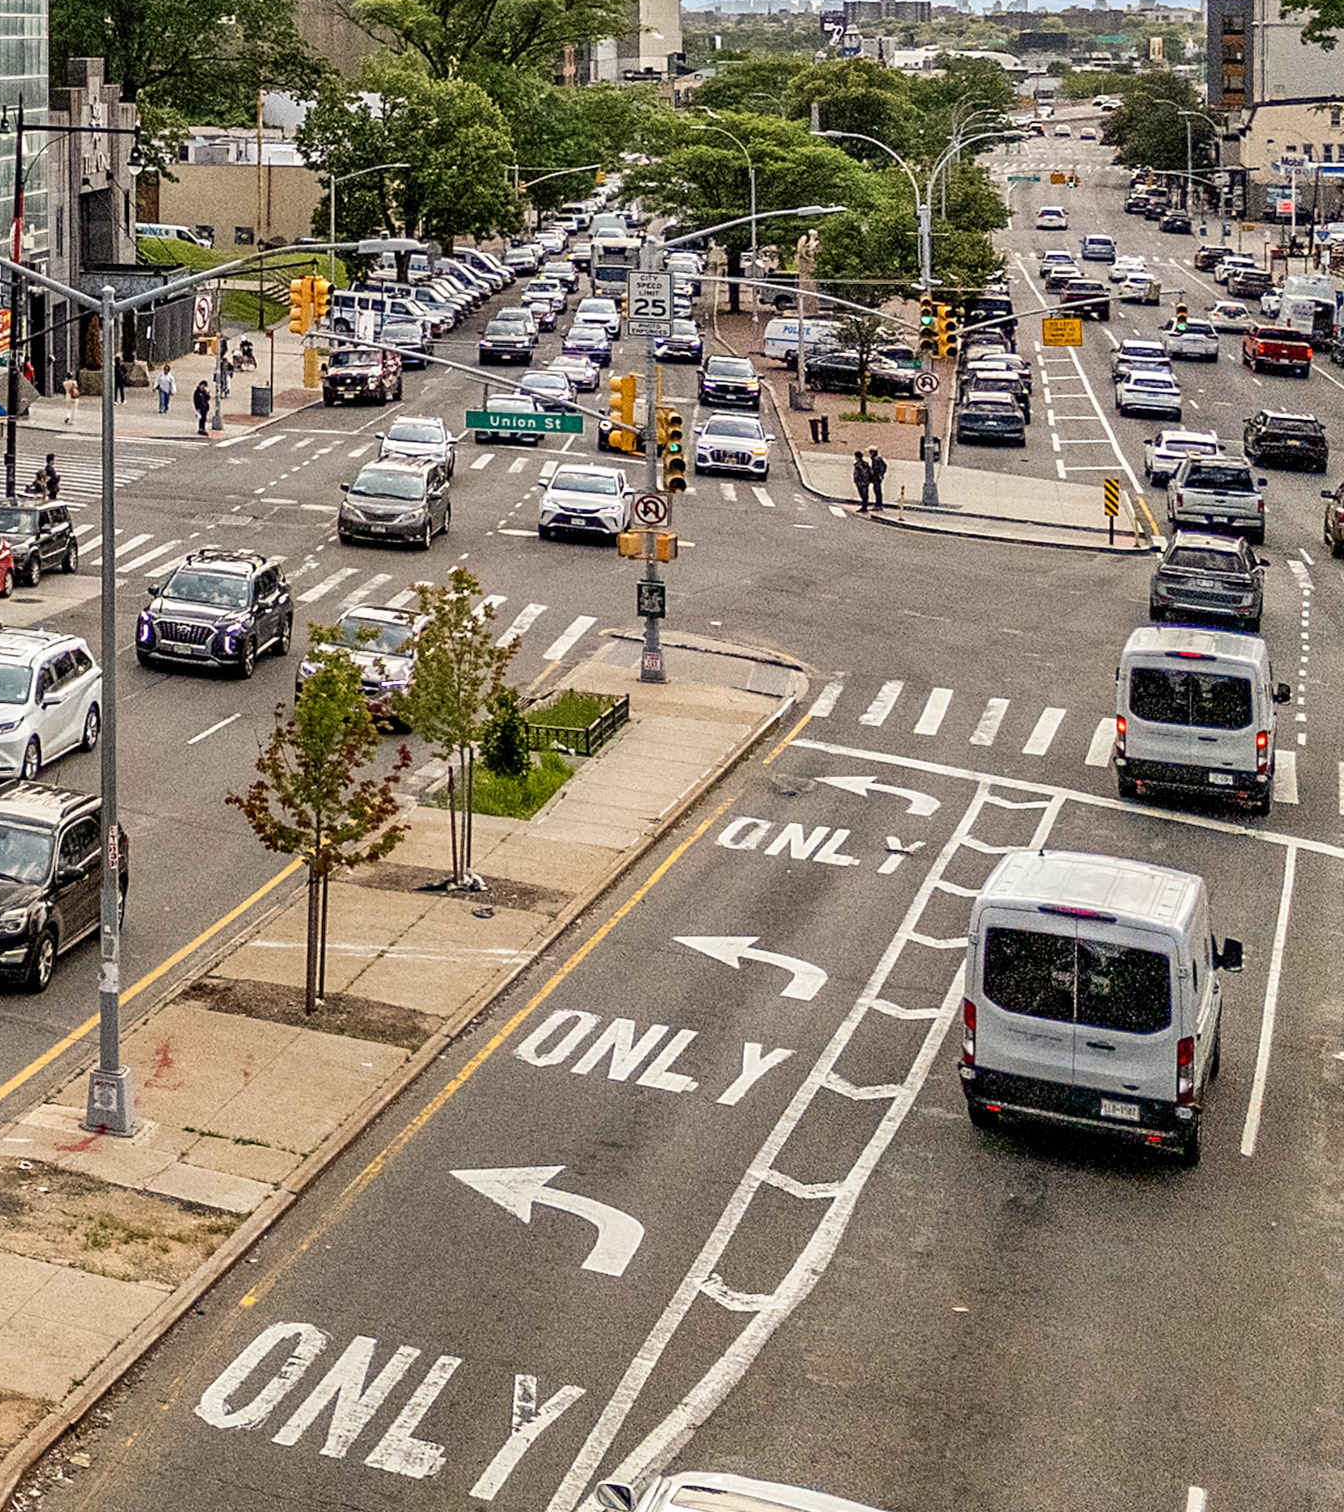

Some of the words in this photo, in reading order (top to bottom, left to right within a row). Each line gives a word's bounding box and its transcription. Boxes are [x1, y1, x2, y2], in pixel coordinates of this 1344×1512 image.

[1280, 155, 1304, 167] Mobil
[633, 298, 666, 317] 25
[489, 415, 537, 428] Union
[544, 418, 561, 430] St
[716, 816, 926, 874] ONLY
[513, 1009, 796, 1106] ONLY
[194, 1321, 587, 1502] ONLY
